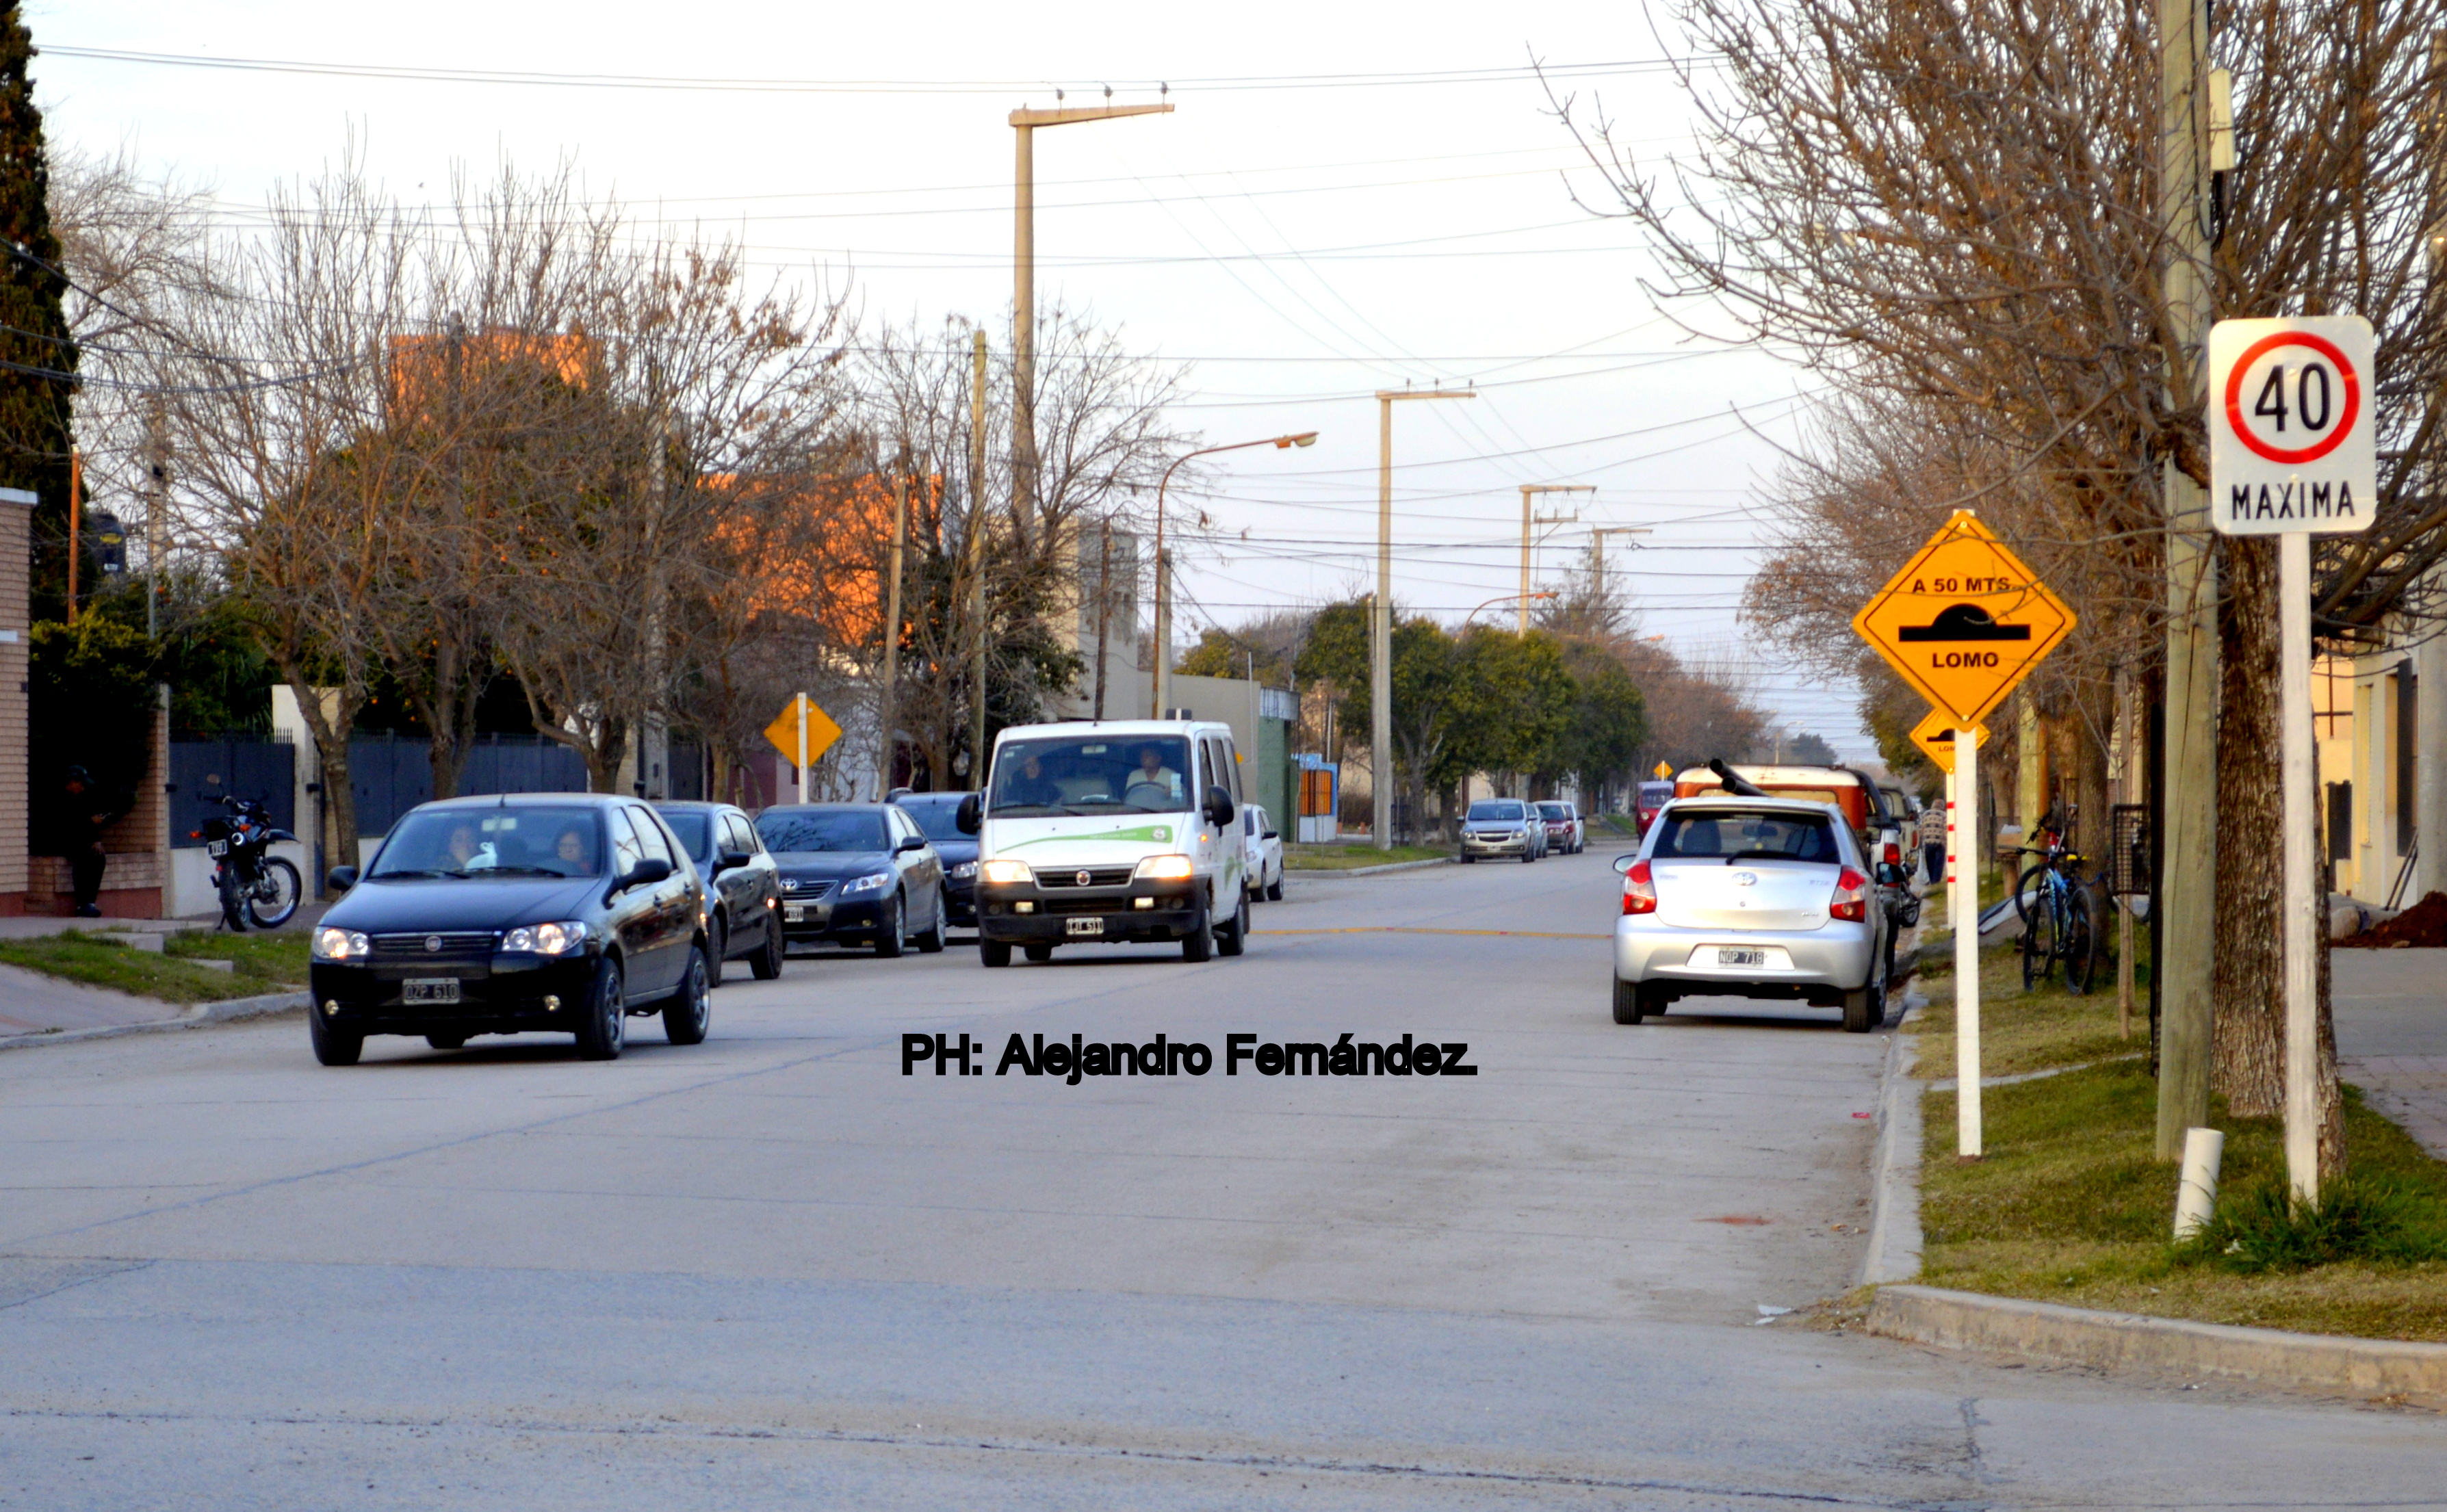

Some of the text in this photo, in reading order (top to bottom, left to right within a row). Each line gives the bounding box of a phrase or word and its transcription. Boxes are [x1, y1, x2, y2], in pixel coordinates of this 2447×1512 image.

[2254, 361, 2331, 432] 40
[2231, 480, 2356, 520] MAXIMA
[1911, 579, 1926, 593] A
[1933, 577, 1958, 592] 50
[1932, 652, 1999, 668] LOMO
[1744, 952, 1763, 964] 718
[433, 984, 458, 999] 610
